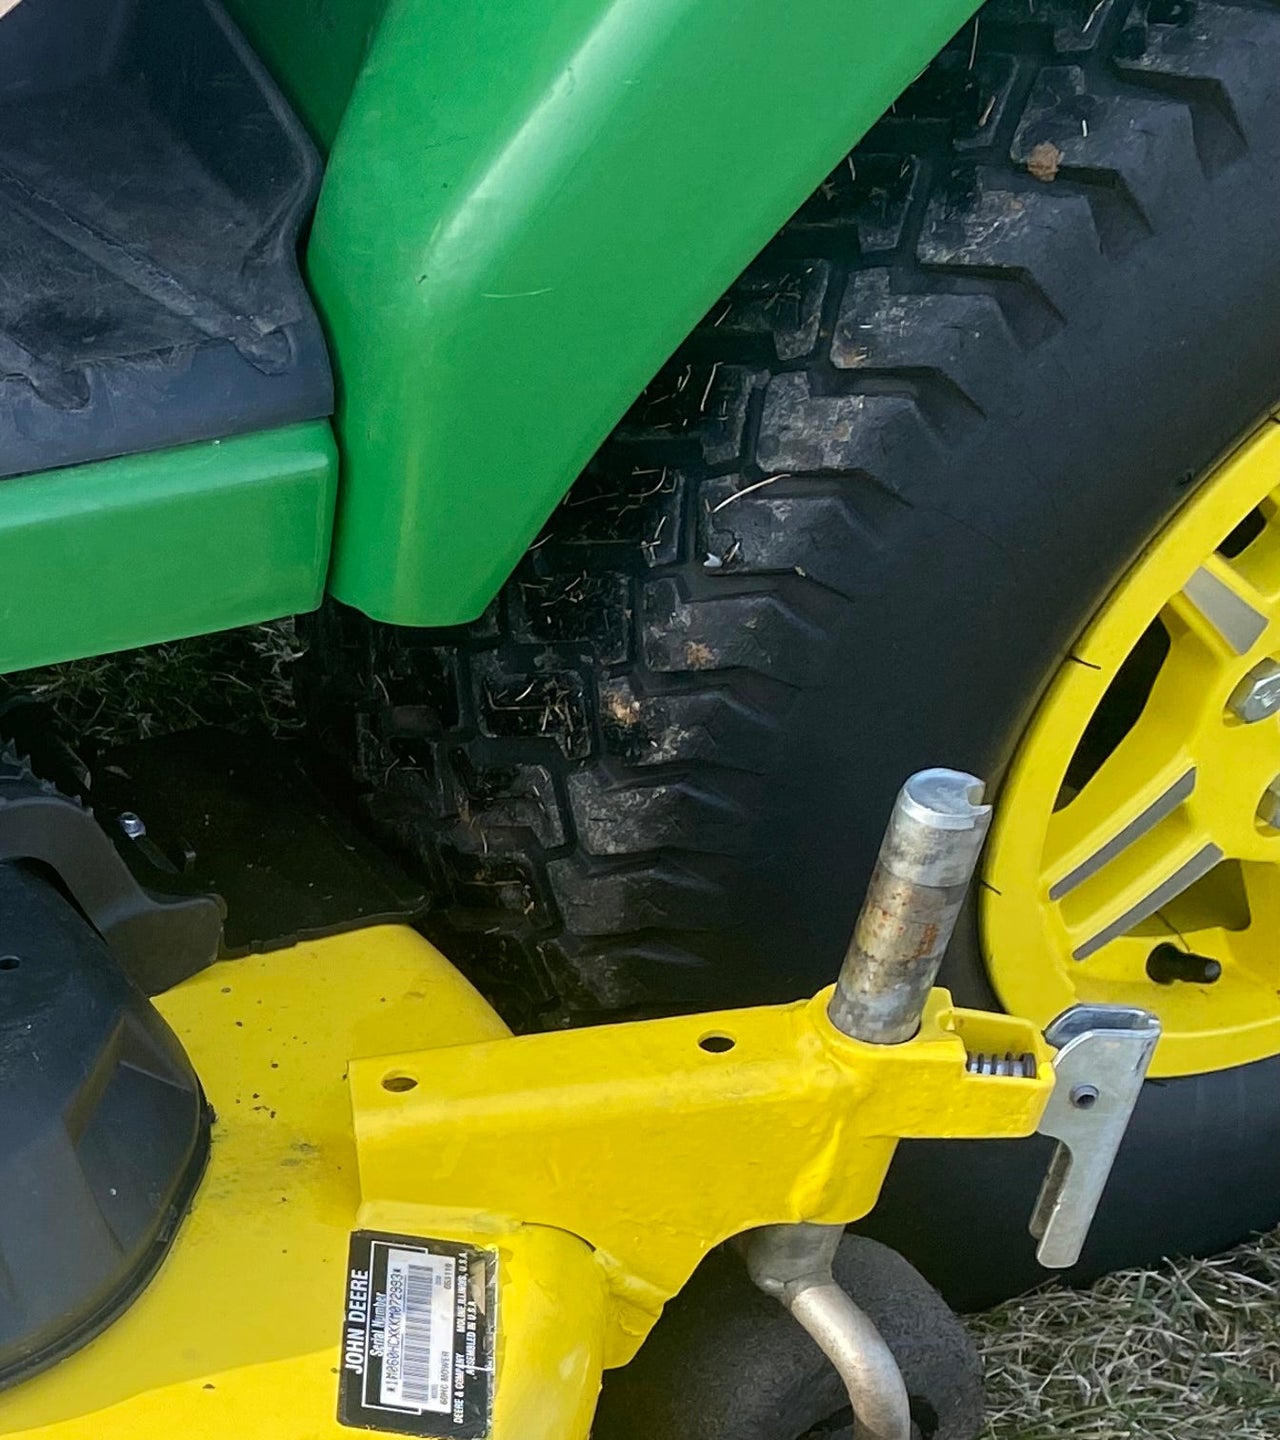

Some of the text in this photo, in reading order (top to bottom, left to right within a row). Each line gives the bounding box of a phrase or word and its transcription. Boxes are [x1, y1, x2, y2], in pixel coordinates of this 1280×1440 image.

[345, 1269, 368, 1374] JOHN DEERE
[370, 1293, 386, 1356] Serial Number
[441, 1351, 450, 1382] MOWER
[456, 1353, 465, 1389] COMPANY
[454, 1398, 464, 1423] DEERE
